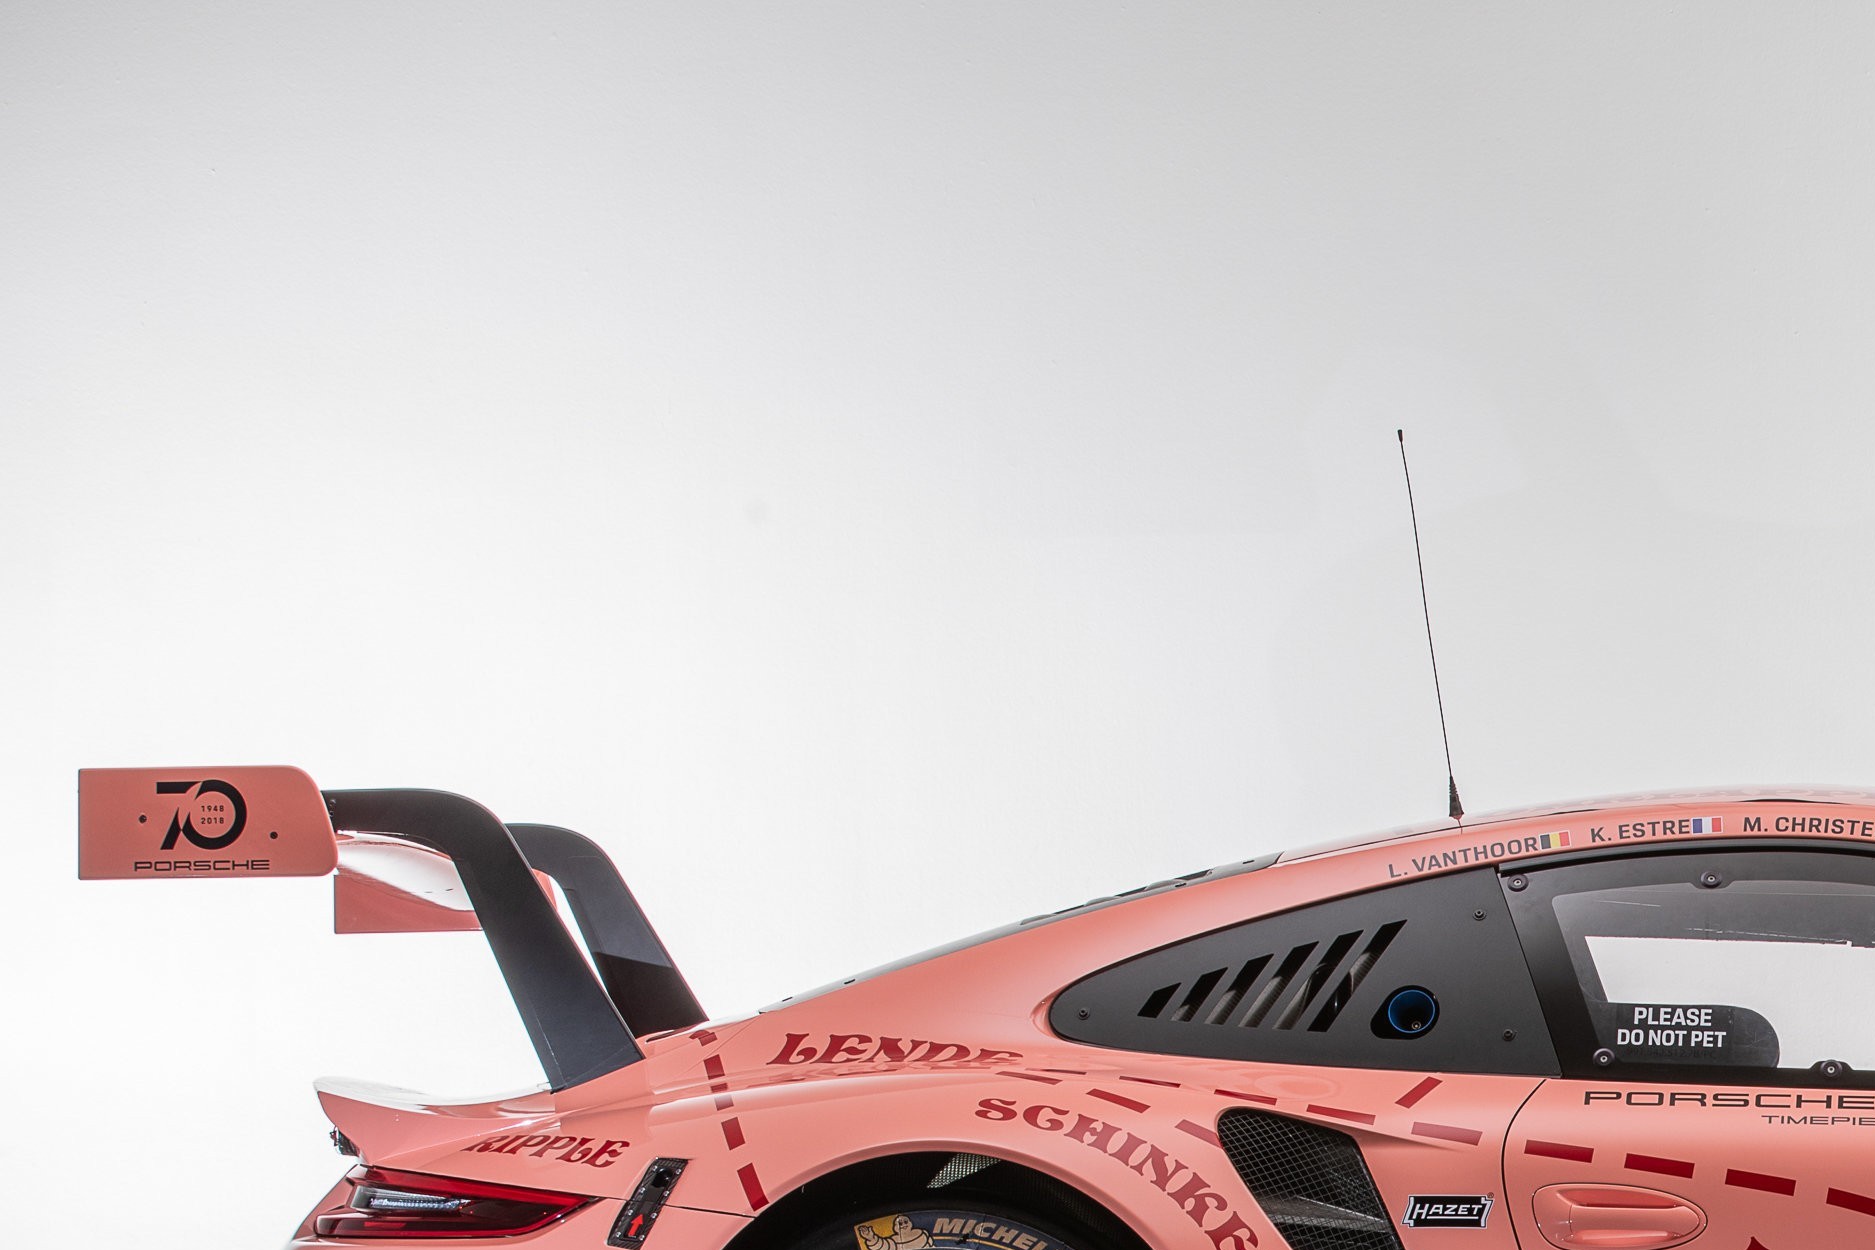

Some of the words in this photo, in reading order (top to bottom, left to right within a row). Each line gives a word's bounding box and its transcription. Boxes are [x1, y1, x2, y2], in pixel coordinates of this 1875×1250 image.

[200, 804, 225, 814] 1948
[200, 816, 225, 826] 2018
[1387, 862, 1408, 880] L.
[1411, 835, 1539, 875] VANTHOOR
[1590, 826, 1613, 844] K.
[1617, 818, 1692, 840] ESTRE
[1742, 815, 1770, 834] M.
[133, 858, 271, 872] PORSCHE
[1633, 1006, 1713, 1027] PLEASE
[1616, 1028, 1645, 1046] DO
[1648, 1029, 1688, 1047] NOT
[1690, 1030, 1727, 1048] PET
[766, 1032, 1024, 1065] LENDE
[1583, 1090, 1875, 1110] PORSCHE
[1411, 1202, 1483, 1220] HAZET
